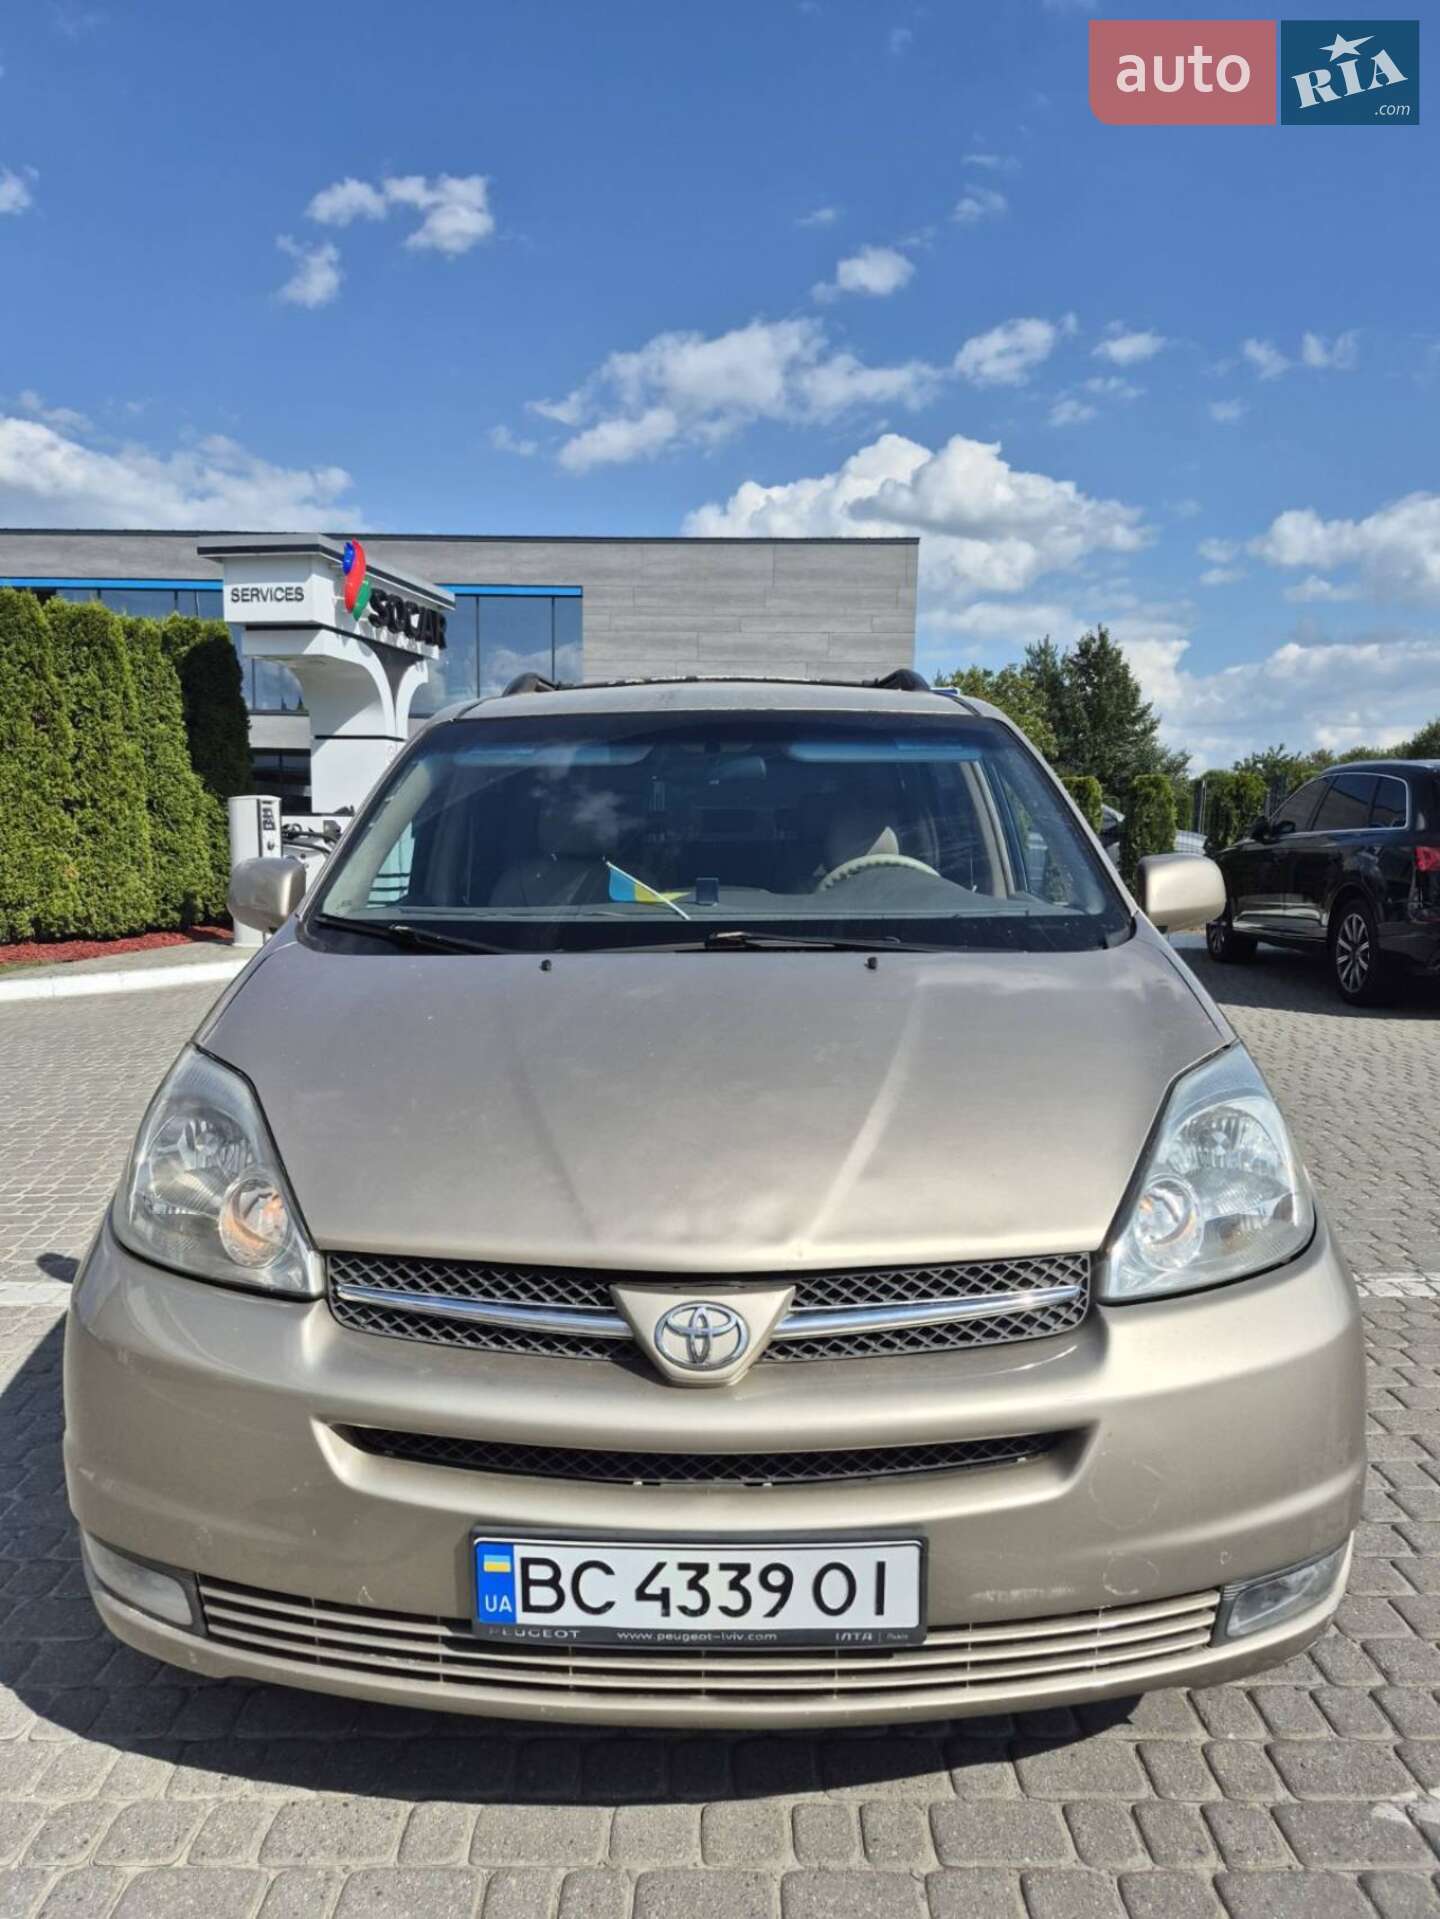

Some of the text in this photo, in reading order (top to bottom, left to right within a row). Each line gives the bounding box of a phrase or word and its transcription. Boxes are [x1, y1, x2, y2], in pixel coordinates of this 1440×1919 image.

[230, 585, 305, 603] SERVICES
[368, 588, 447, 649] SOCAR
[485, 1595, 512, 1613] UA
[520, 1557, 616, 1615] BC
[635, 1561, 794, 1618] 4339
